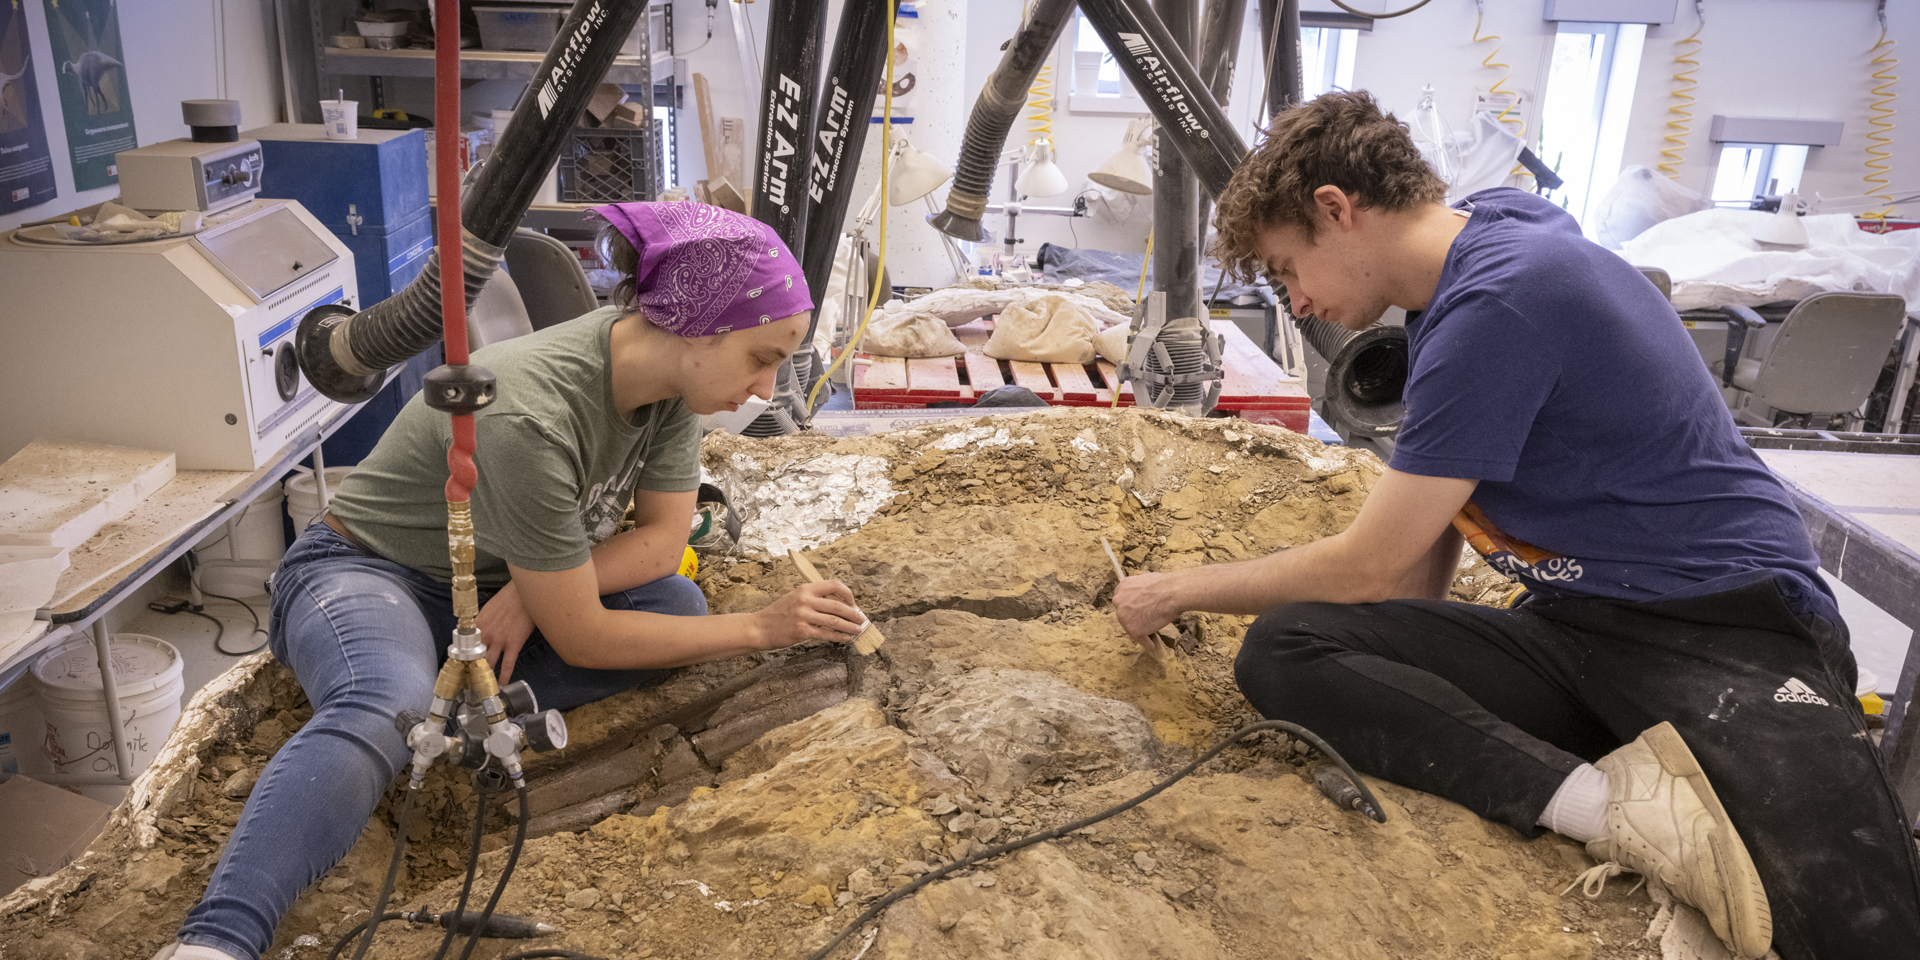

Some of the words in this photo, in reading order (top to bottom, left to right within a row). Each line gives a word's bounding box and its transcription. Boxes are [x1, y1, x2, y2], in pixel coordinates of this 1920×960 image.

[551, 0, 601, 87] Airflow
[557, 36, 592, 92] SYSTEMS
[766, 89, 777, 149] Extraction
[1136, 58, 1175, 111] SYSTEMS
[1177, 117, 1193, 137] INC.
[762, 152, 772, 193] System
[827, 140, 845, 192] Extraction
[840, 100, 855, 139] System
[1773, 692, 1829, 707] adidas
